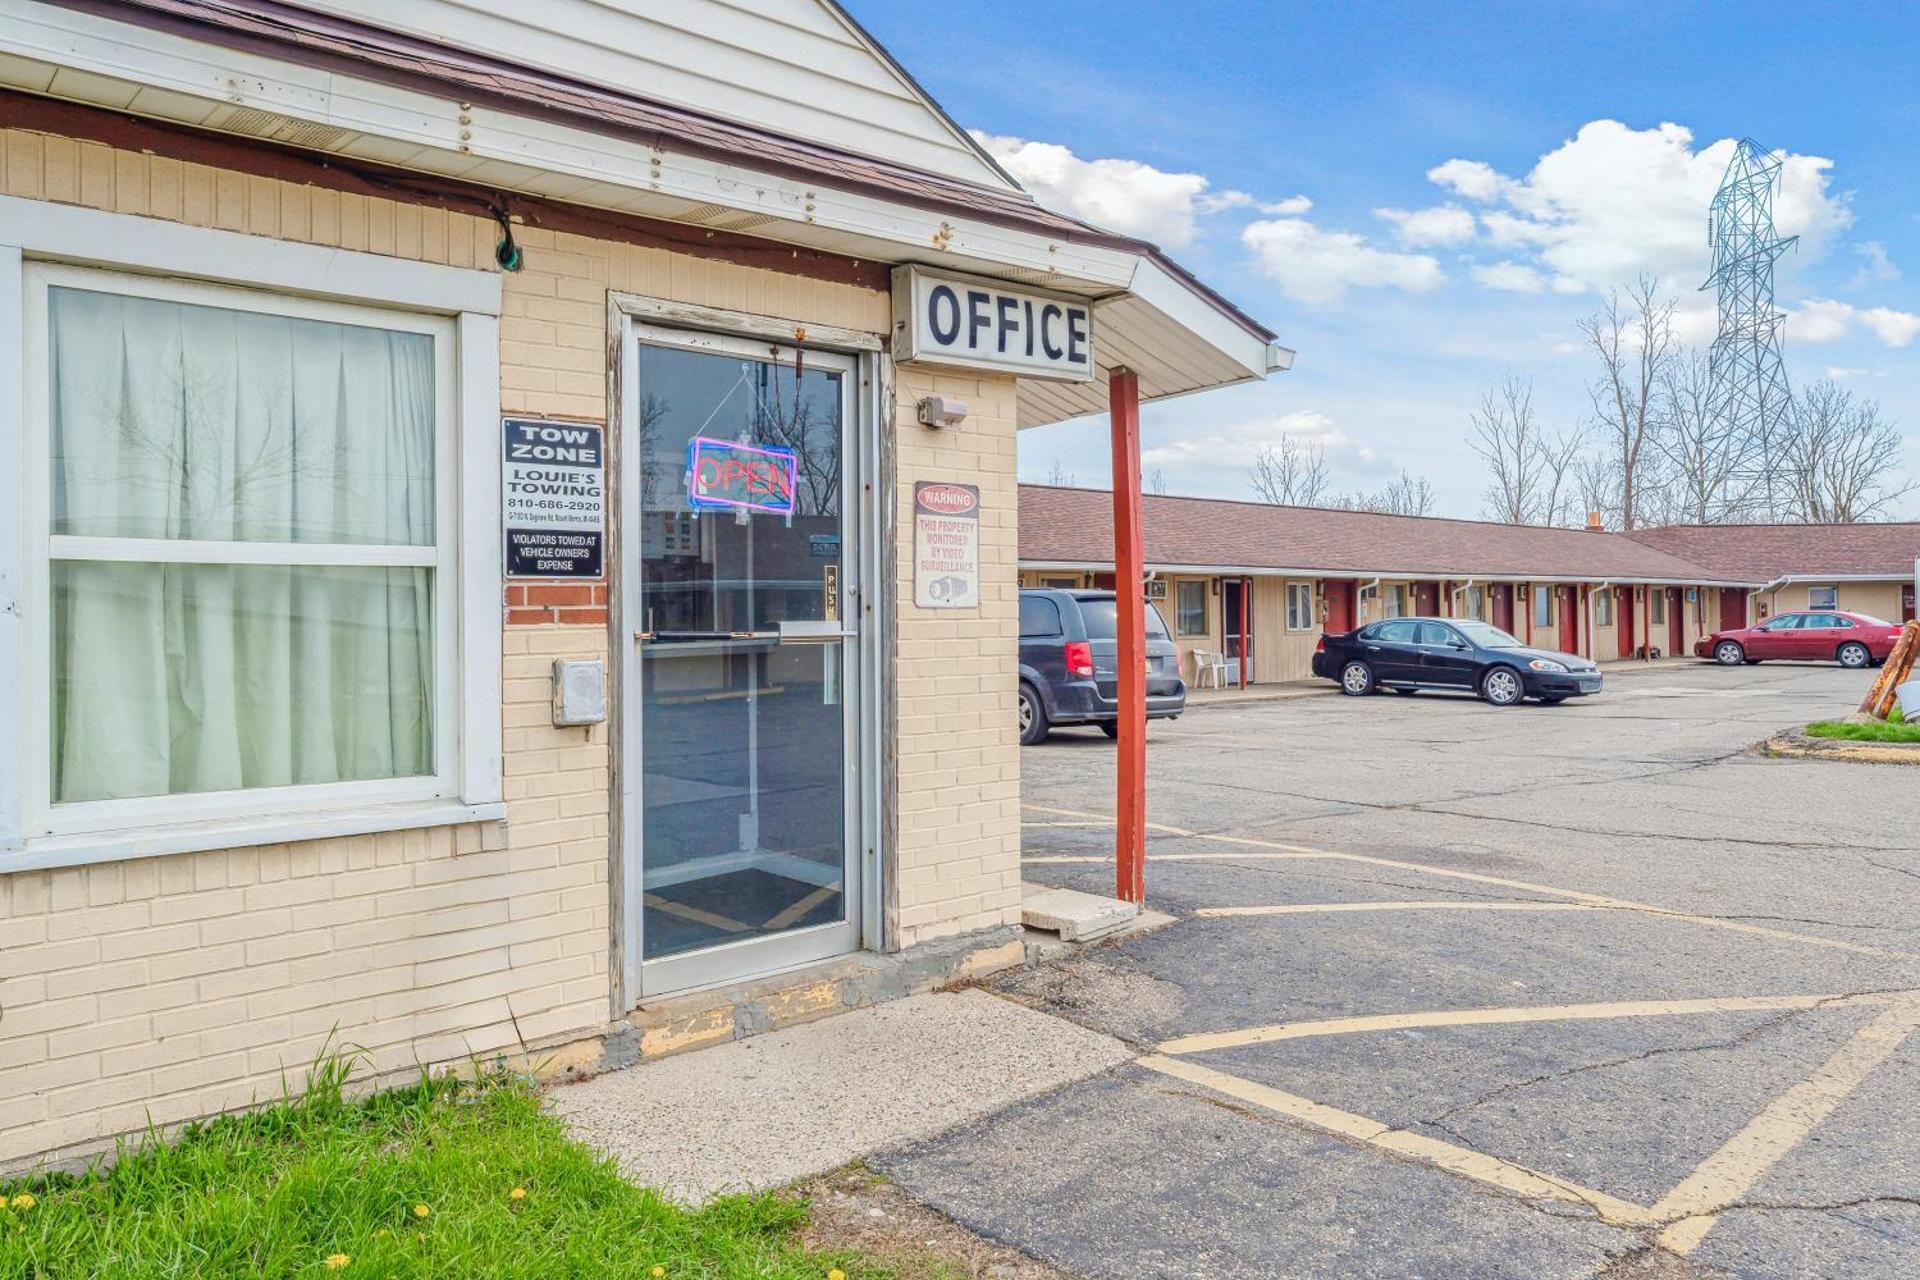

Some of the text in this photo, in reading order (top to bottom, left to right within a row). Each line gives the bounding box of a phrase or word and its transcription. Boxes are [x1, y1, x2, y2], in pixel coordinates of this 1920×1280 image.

[928, 284, 1087, 364] OFFICE
[519, 425, 589, 445] TOW
[511, 443, 596, 463] ZONE
[513, 469, 596, 485] LOUIE'S
[698, 456, 791, 497] OPEN
[507, 482, 600, 497] TOWING
[508, 498, 600, 512] 810-686-2920
[924, 491, 972, 506] WARNING
[919, 519, 975, 533] THIS PROPERTY
[512, 534, 596, 546] VIOLATORS TOWED AT
[927, 533, 968, 546] MONITORED
[520, 548, 590, 559] VEHICLE OWNER'S
[941, 548, 964, 560] VIDEO
[537, 560, 574, 570] EXPENSE
[920, 560, 974, 573] SURVEILLANCE
